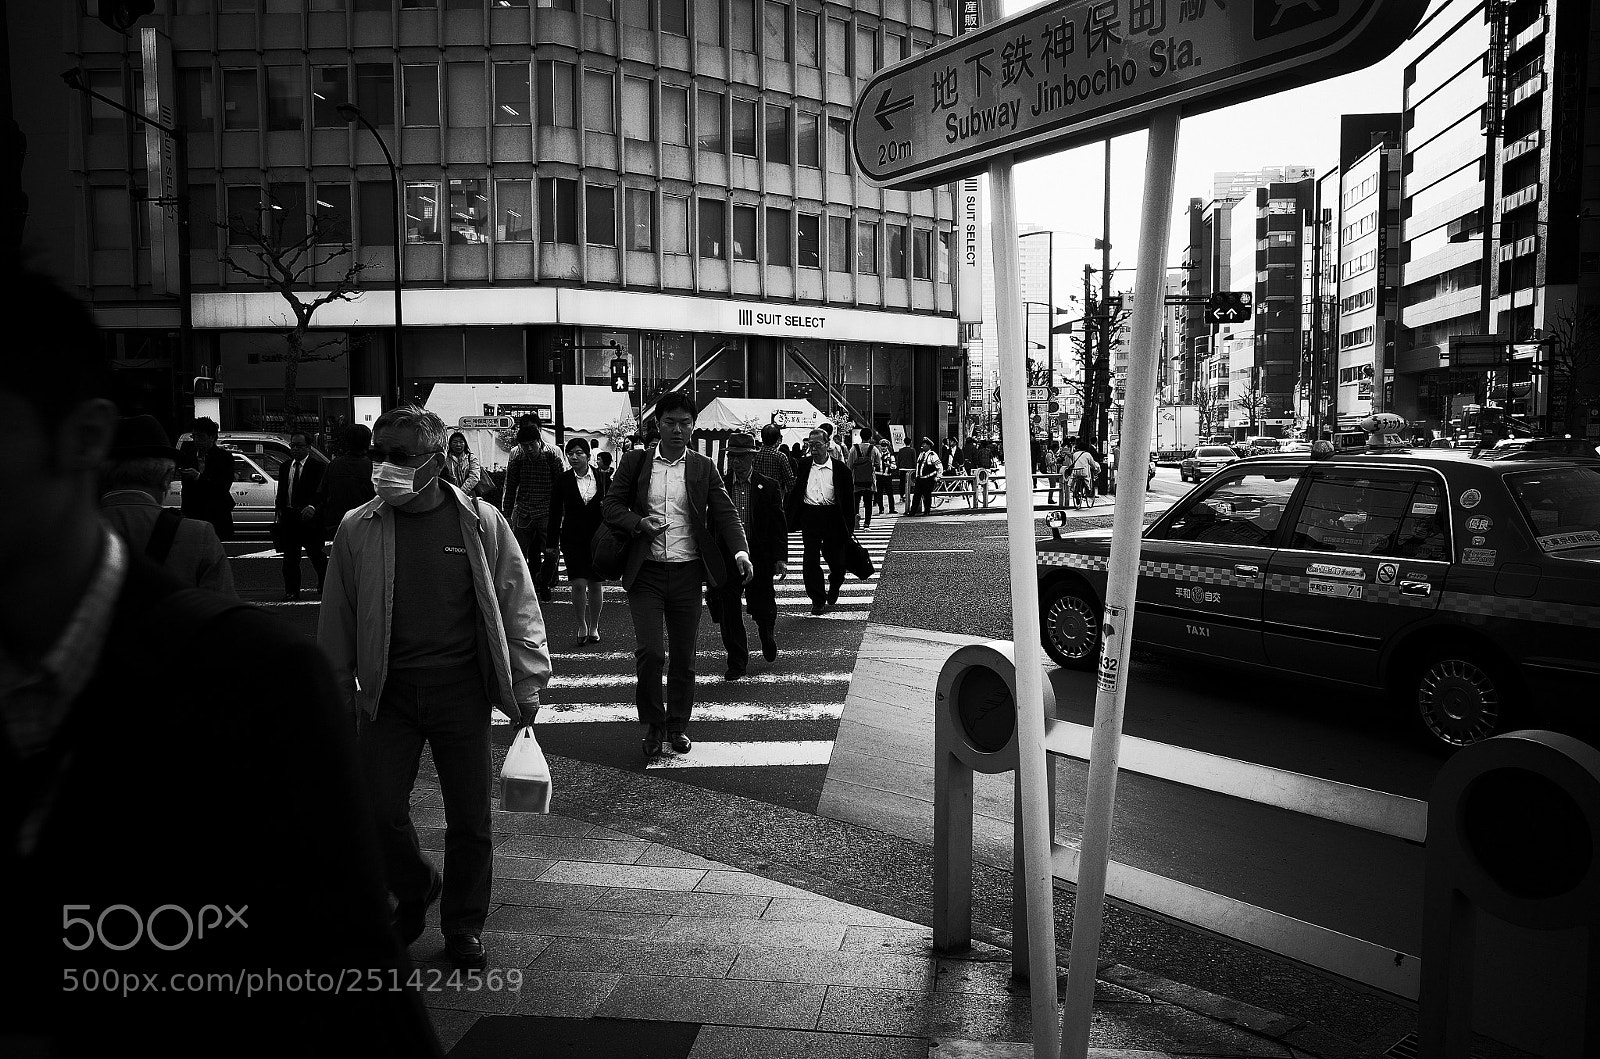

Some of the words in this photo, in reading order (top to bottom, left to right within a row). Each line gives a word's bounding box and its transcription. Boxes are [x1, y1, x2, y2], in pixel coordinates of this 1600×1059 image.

[945, 98, 1021, 144] Subway
[1031, 56, 1138, 117] Jinbocho
[1149, 36, 1202, 78] Sta.
[877, 139, 913, 167] 20m
[966, 195, 976, 222] SUIT
[966, 224, 976, 267] SELECT
[756, 313, 782, 325] SUIT
[784, 315, 826, 328] SELECT
[1175, 587, 1191, 599] 平和
[1204, 590, 1221, 604] 自交
[1347, 585, 1362, 599] 71
[1185, 624, 1210, 637] TAXI
